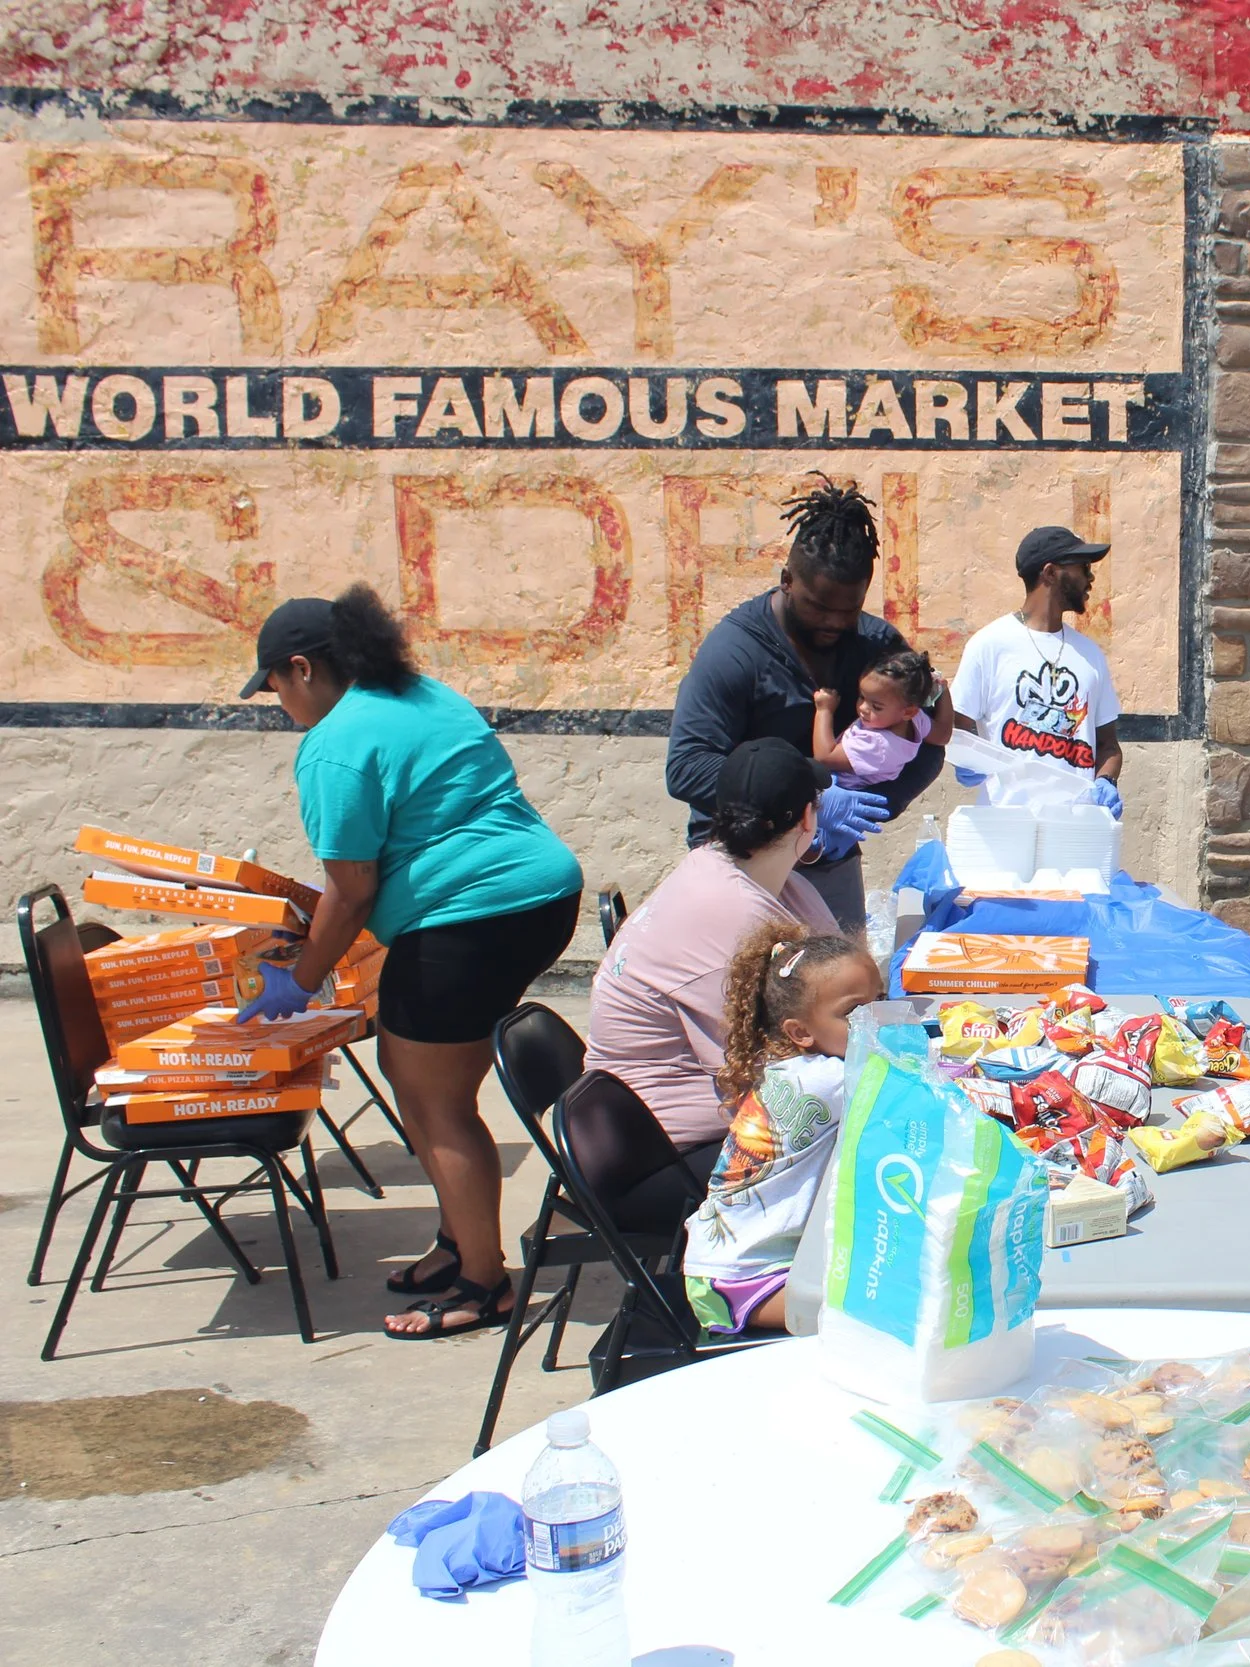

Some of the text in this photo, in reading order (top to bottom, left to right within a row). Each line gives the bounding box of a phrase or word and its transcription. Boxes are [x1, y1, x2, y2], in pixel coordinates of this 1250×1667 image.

[28, 150, 1120, 358] RAY'S
[1, 372, 1149, 443] WORLD FAMOUS MARKET
[1016, 662, 1079, 709] NO
[1001, 718, 1096, 769] HANDOUTS
[164, 852, 192, 865] REPEAT
[162, 949, 190, 960] REPEAT
[170, 967, 199, 978] REPEAT
[965, 980, 999, 988] CHILLIN'
[170, 989, 197, 999] REPEAT
[158, 1053, 253, 1066] HOT-N-READY
[173, 1096, 280, 1116] HOT-N-READY
[914, 1120, 927, 1159] simply
[832, 1246, 848, 1280] 500
[866, 1209, 889, 1300] napkins
[955, 1283, 969, 1318] 500
